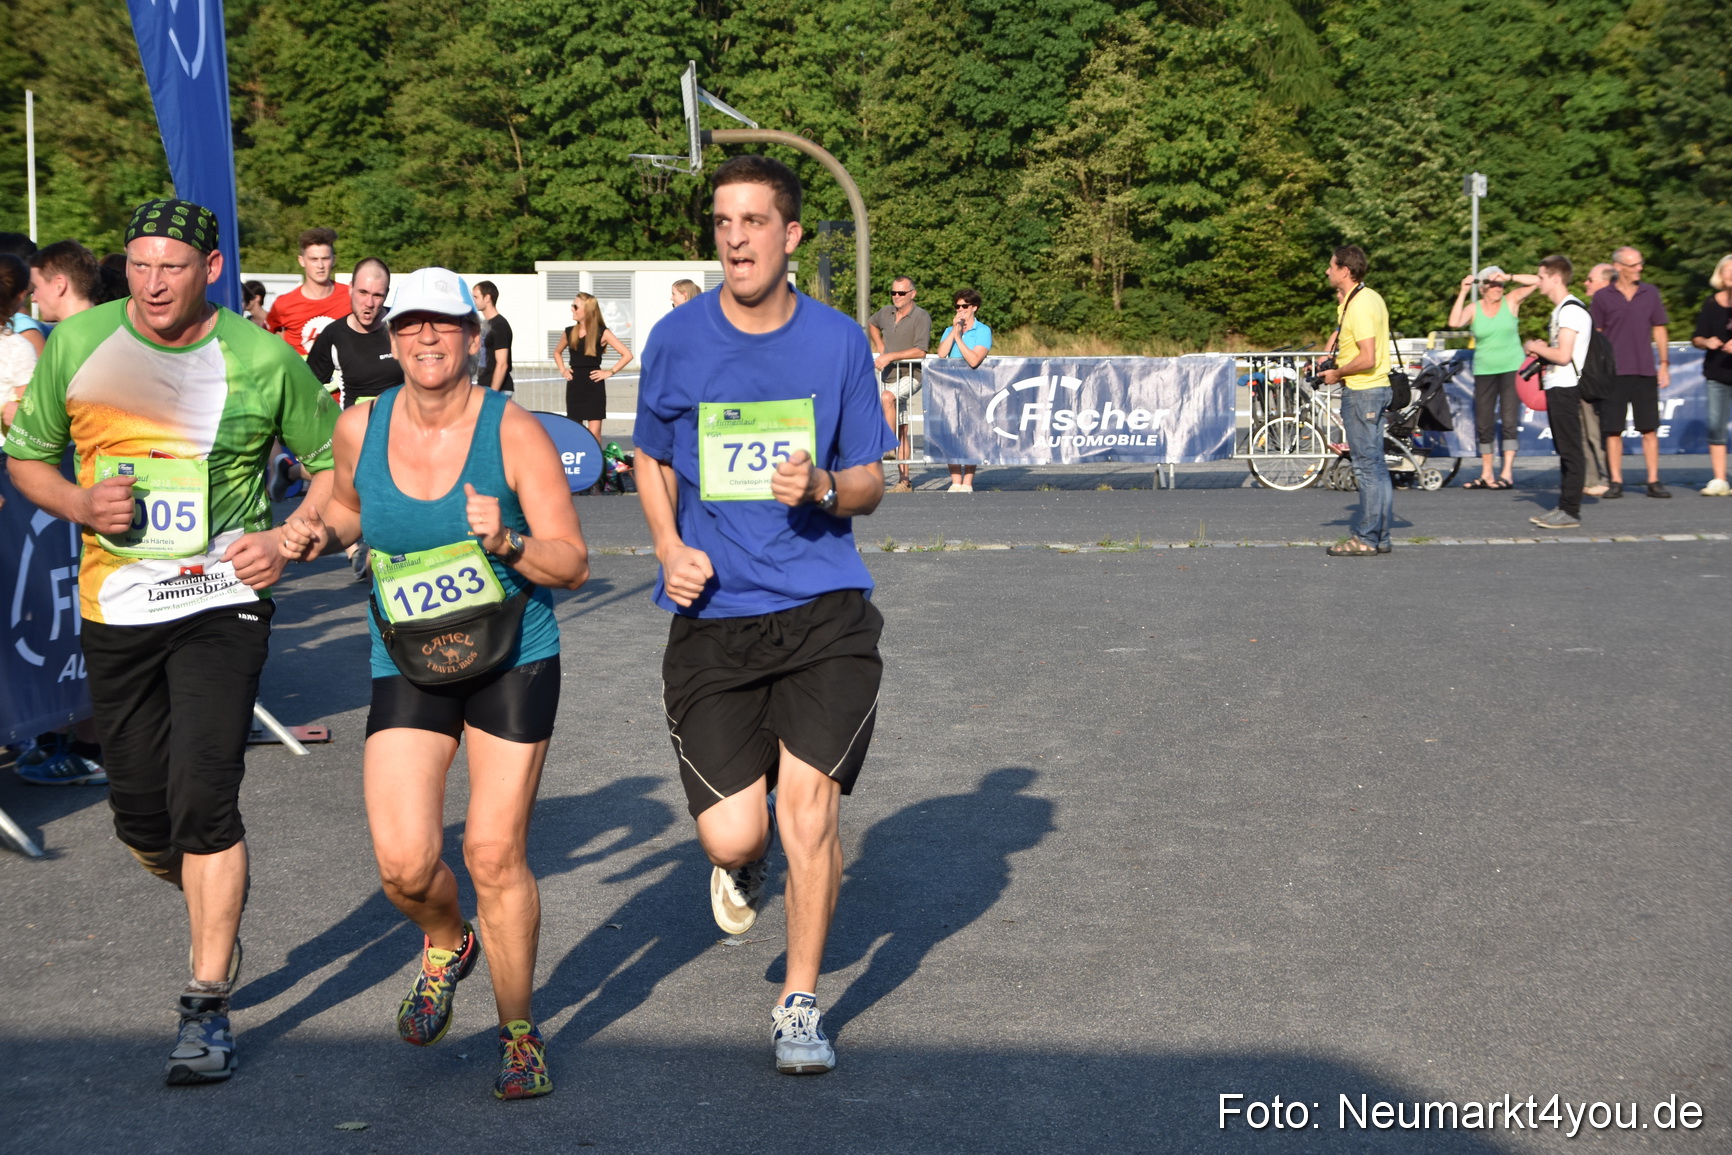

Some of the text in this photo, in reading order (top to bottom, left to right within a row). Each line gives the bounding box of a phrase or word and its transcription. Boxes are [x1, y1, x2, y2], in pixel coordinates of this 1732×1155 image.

[1019, 401, 1170, 431] Fischer
[1033, 434, 1158, 448] AUTOMOBILE
[723, 441, 791, 473] 735
[729, 479, 763, 487] Christoph
[151, 537, 175, 545] Härteis
[393, 567, 485, 617] 1283
[422, 632, 474, 656] CAMEL
[426, 651, 478, 674] TRAVEL-BAGS
